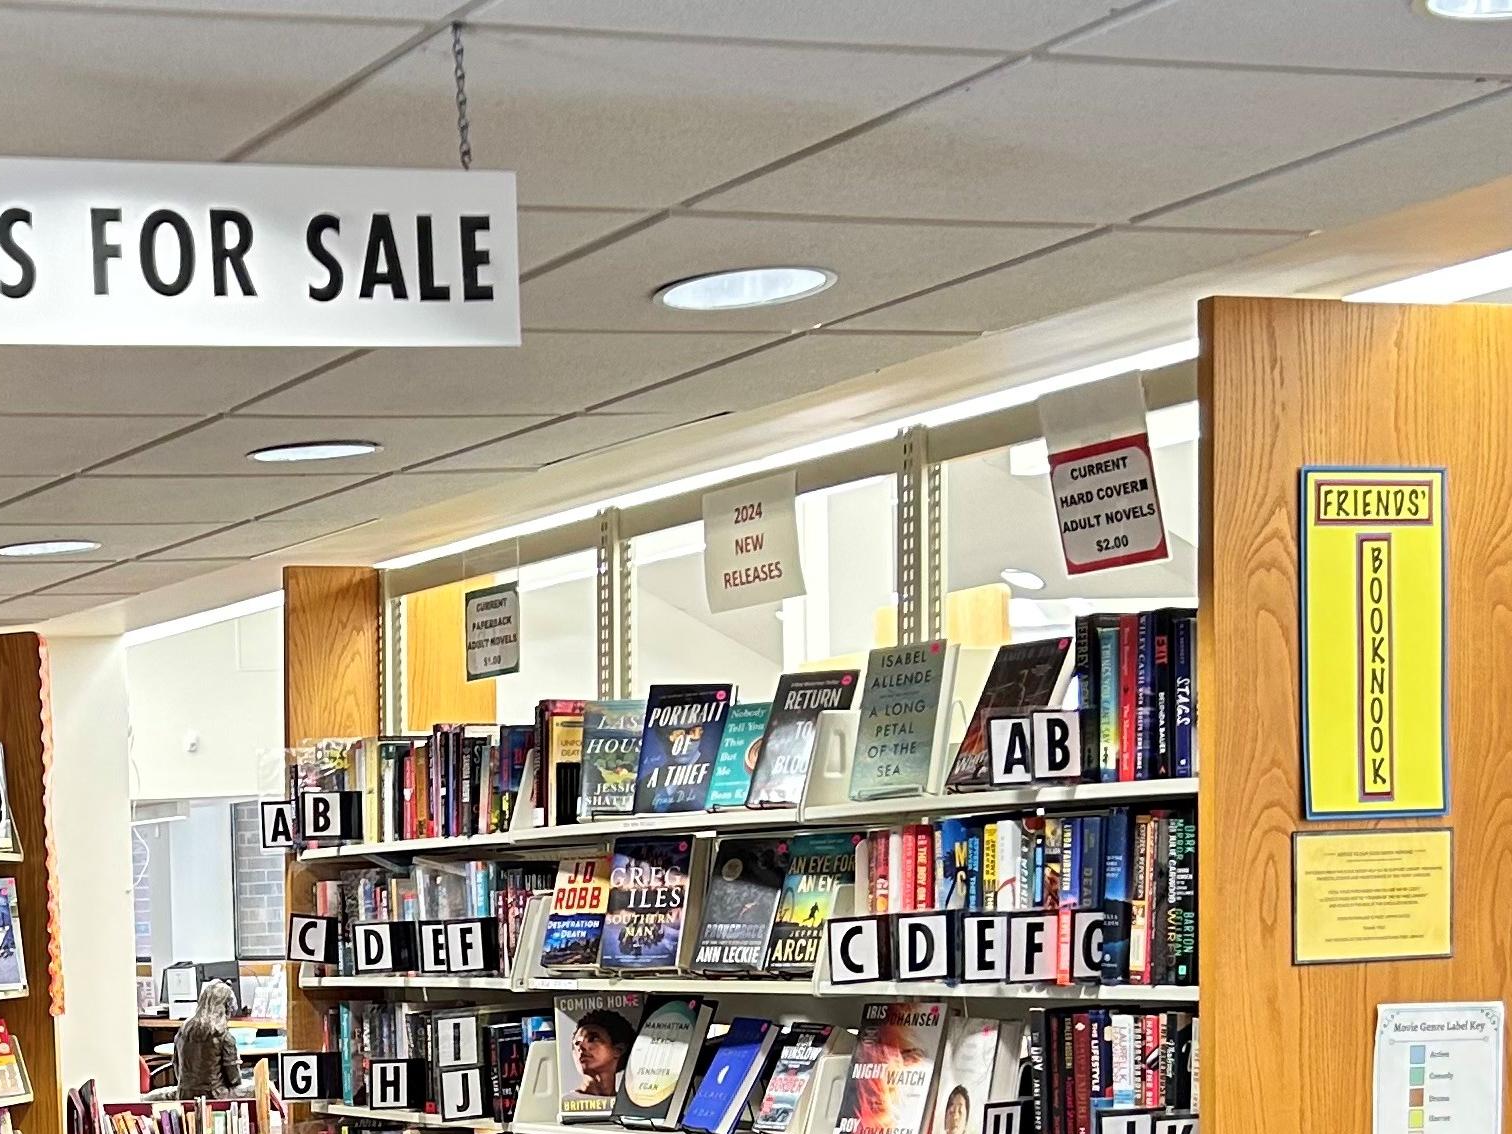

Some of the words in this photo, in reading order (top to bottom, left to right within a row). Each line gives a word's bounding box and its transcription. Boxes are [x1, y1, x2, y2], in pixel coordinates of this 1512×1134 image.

[90, 206, 258, 297] FOR
[306, 213, 495, 303] SALE
[1070, 456, 1129, 482] CURRENT
[1059, 491, 1094, 509] HARD
[1323, 488, 1427, 518] FRIENDS'
[733, 504, 764, 526] 2024
[1061, 517, 1102, 535] ADULT
[1105, 504, 1157, 526] NOVELS
[734, 534, 765, 557] NEW
[1095, 533, 1130, 553] $2.00
[723, 562, 783, 590] RELEASES
[880, 651, 928, 668] ISABEL
[871, 668, 933, 689] ALLENDE
[784, 687, 842, 710] RETURN
[884, 700, 926, 717] LONG
[647, 701, 727, 729] PORTRAIT
[874, 724, 915, 739] PETAL
[670, 735, 692, 756] OF
[866, 744, 890, 758] OF
[894, 741, 918, 755] THE
[1002, 721, 1031, 775] A
[1047, 716, 1070, 768] B
[665, 763, 709, 786] THIEF
[876, 763, 901, 778] SEA
[271, 807, 292, 842] A
[312, 796, 331, 834] B
[609, 865, 682, 890] GREG
[553, 887, 603, 911] ROBB
[627, 886, 682, 910] ILES
[298, 920, 318, 957] C
[364, 928, 384, 966] D
[460, 926, 473, 966] F
[695, 946, 722, 964] ANN
[722, 945, 761, 964] LECKIE
[839, 924, 865, 975] C
[907, 922, 934, 973] D
[975, 918, 996, 971] E
[1024, 920, 1045, 975] F
[559, 997, 603, 1013] COMING
[606, 994, 639, 1008] HOME
[865, 1004, 887, 1020] IRIS
[289, 1060, 312, 1095] G
[380, 1065, 402, 1103] H
[456, 1073, 470, 1112] J
[851, 1062, 887, 1079] NIGHT
[886, 1068, 926, 1087] WATCH
